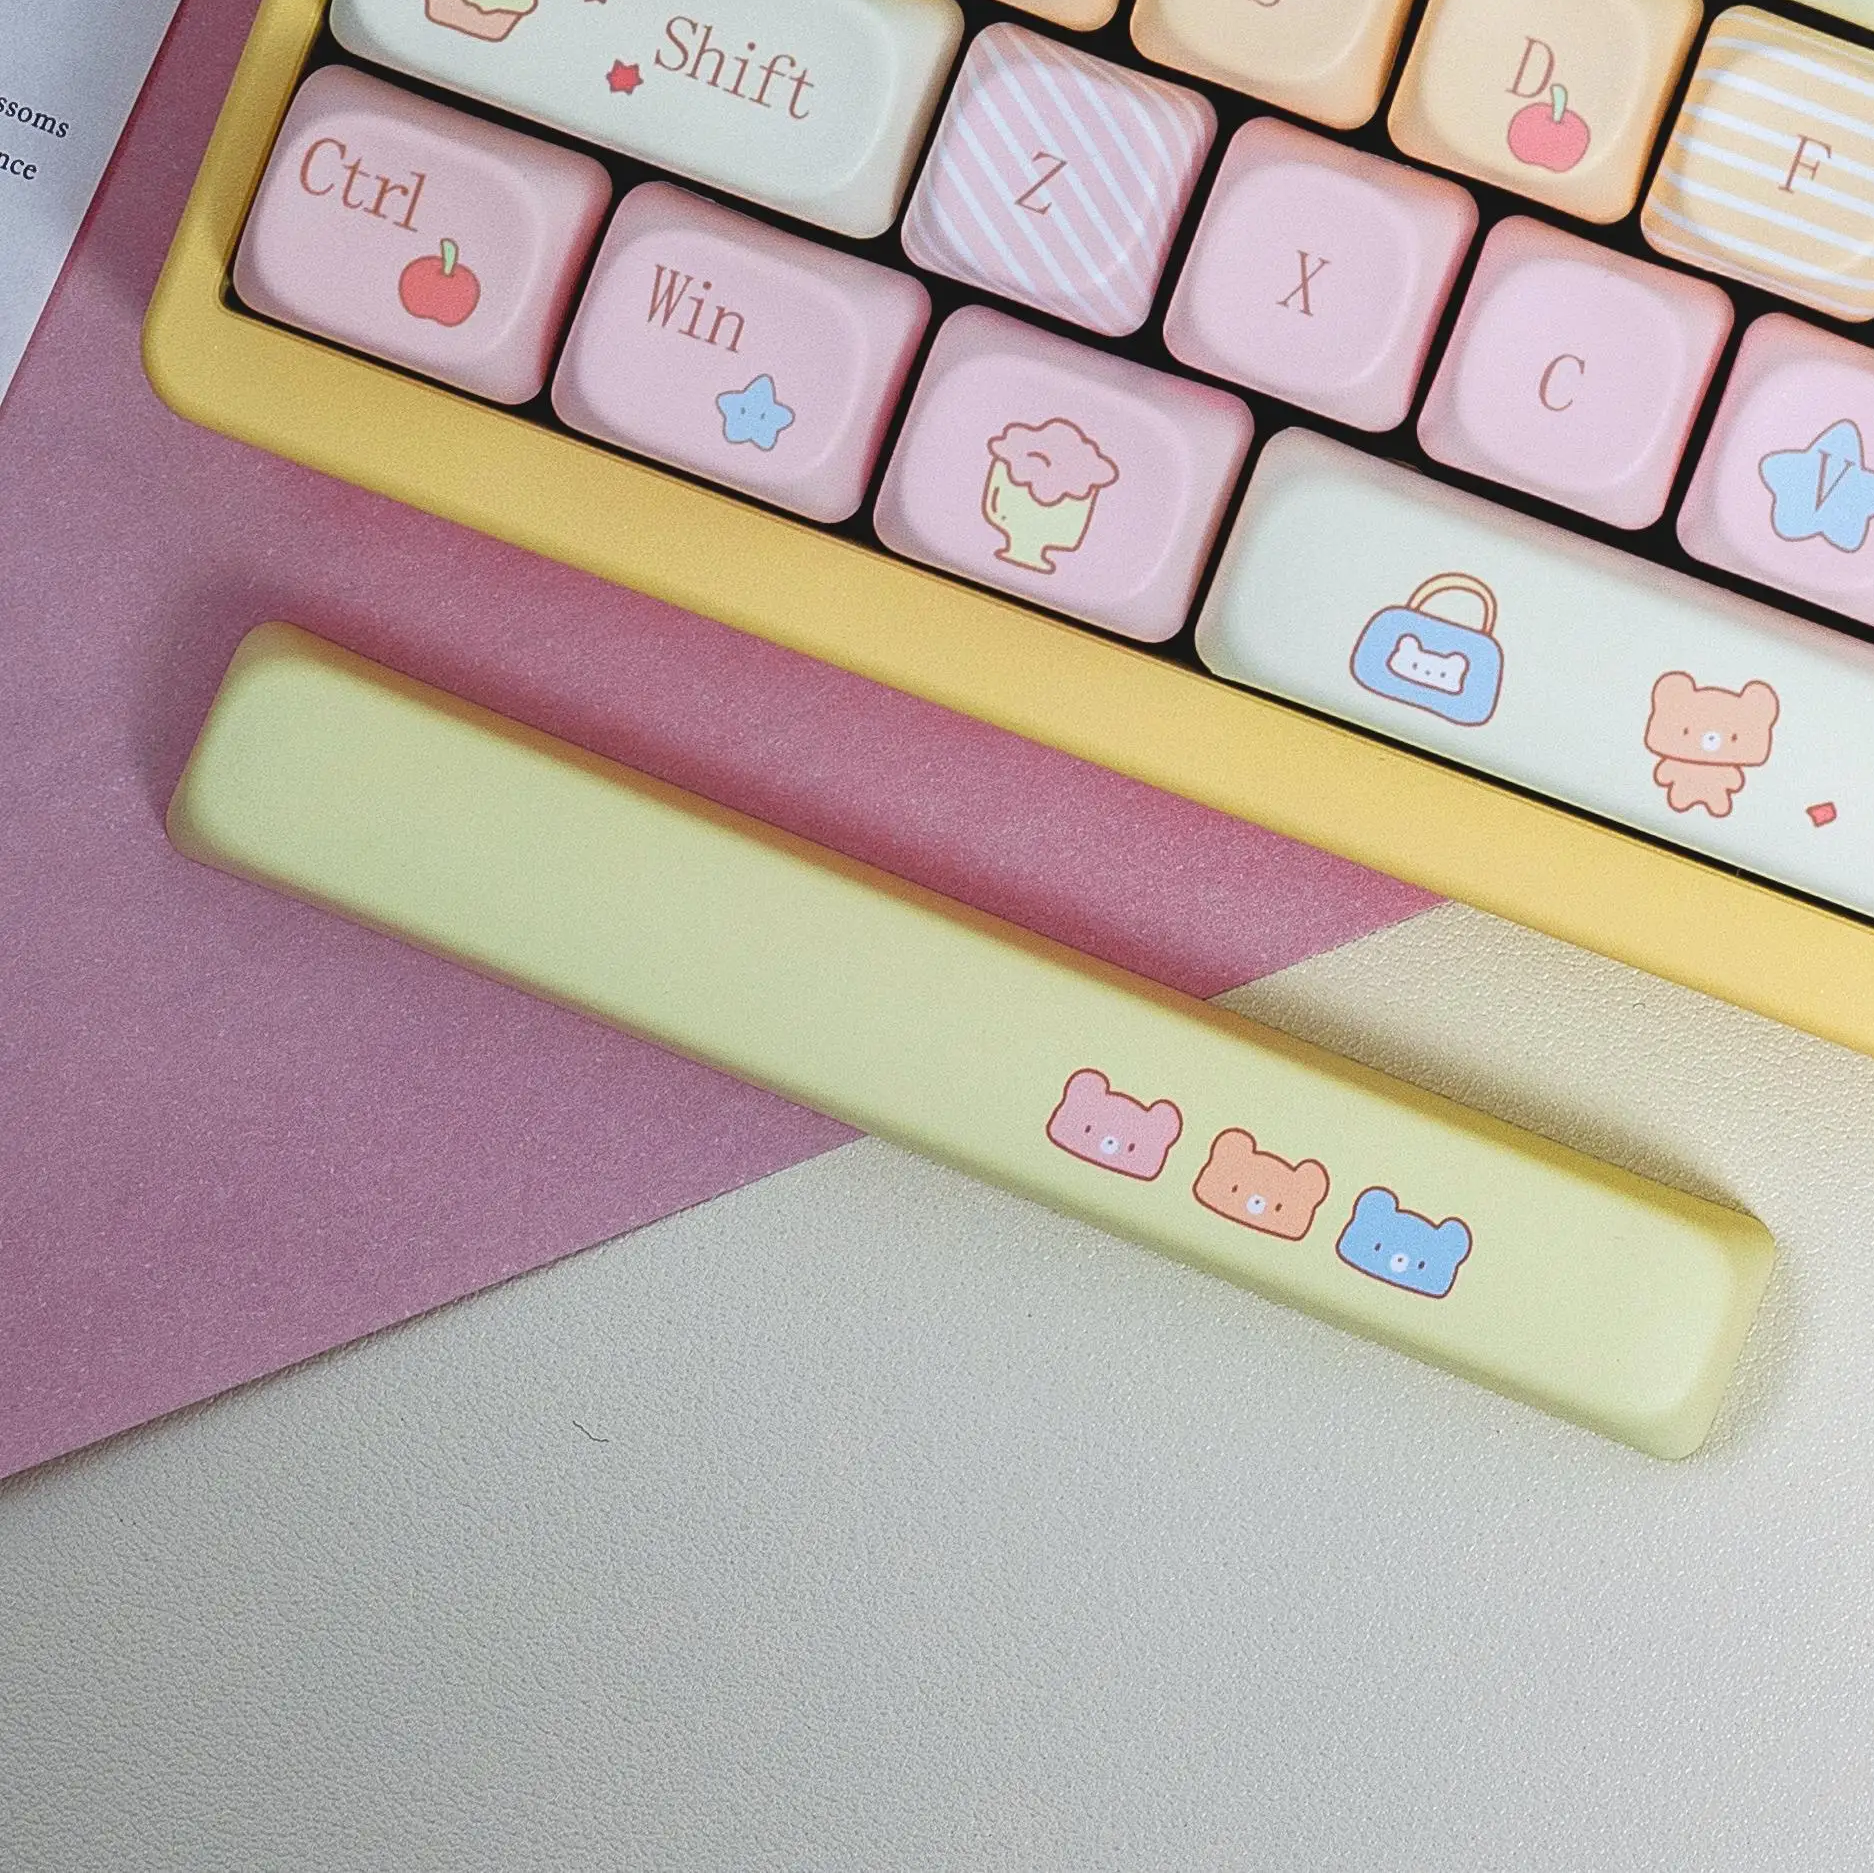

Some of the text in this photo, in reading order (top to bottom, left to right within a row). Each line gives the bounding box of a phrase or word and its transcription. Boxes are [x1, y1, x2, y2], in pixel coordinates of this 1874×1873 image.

[653, 15, 817, 121] Shift
[1504, 36, 1554, 98] D
[299, 138, 426, 233] Ctrl
[1015, 151, 1067, 216] Z
[1778, 136, 1832, 194] F
[649, 264, 747, 354] Win
[1277, 249, 1331, 316] X
[1539, 354, 1585, 413] C
[1813, 450, 1854, 513] V
